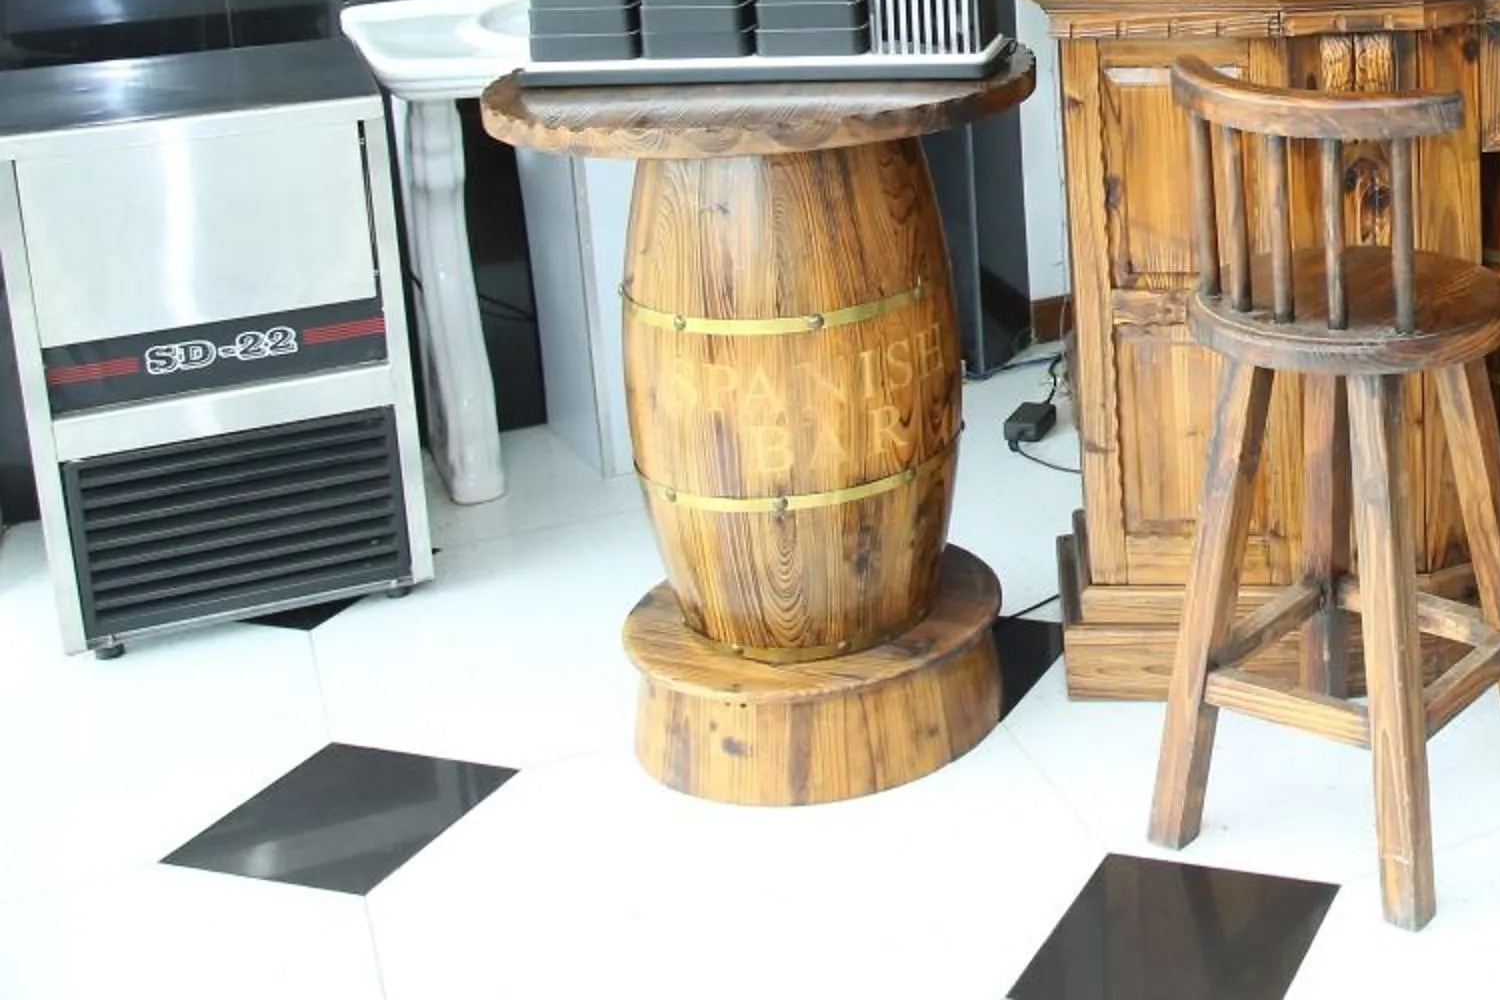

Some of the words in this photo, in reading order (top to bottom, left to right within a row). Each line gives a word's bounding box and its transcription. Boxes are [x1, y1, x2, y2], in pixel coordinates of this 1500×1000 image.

[145, 325, 299, 375] SD-22
[664, 322, 945, 417] SPANISH
[749, 404, 908, 473] BAR
